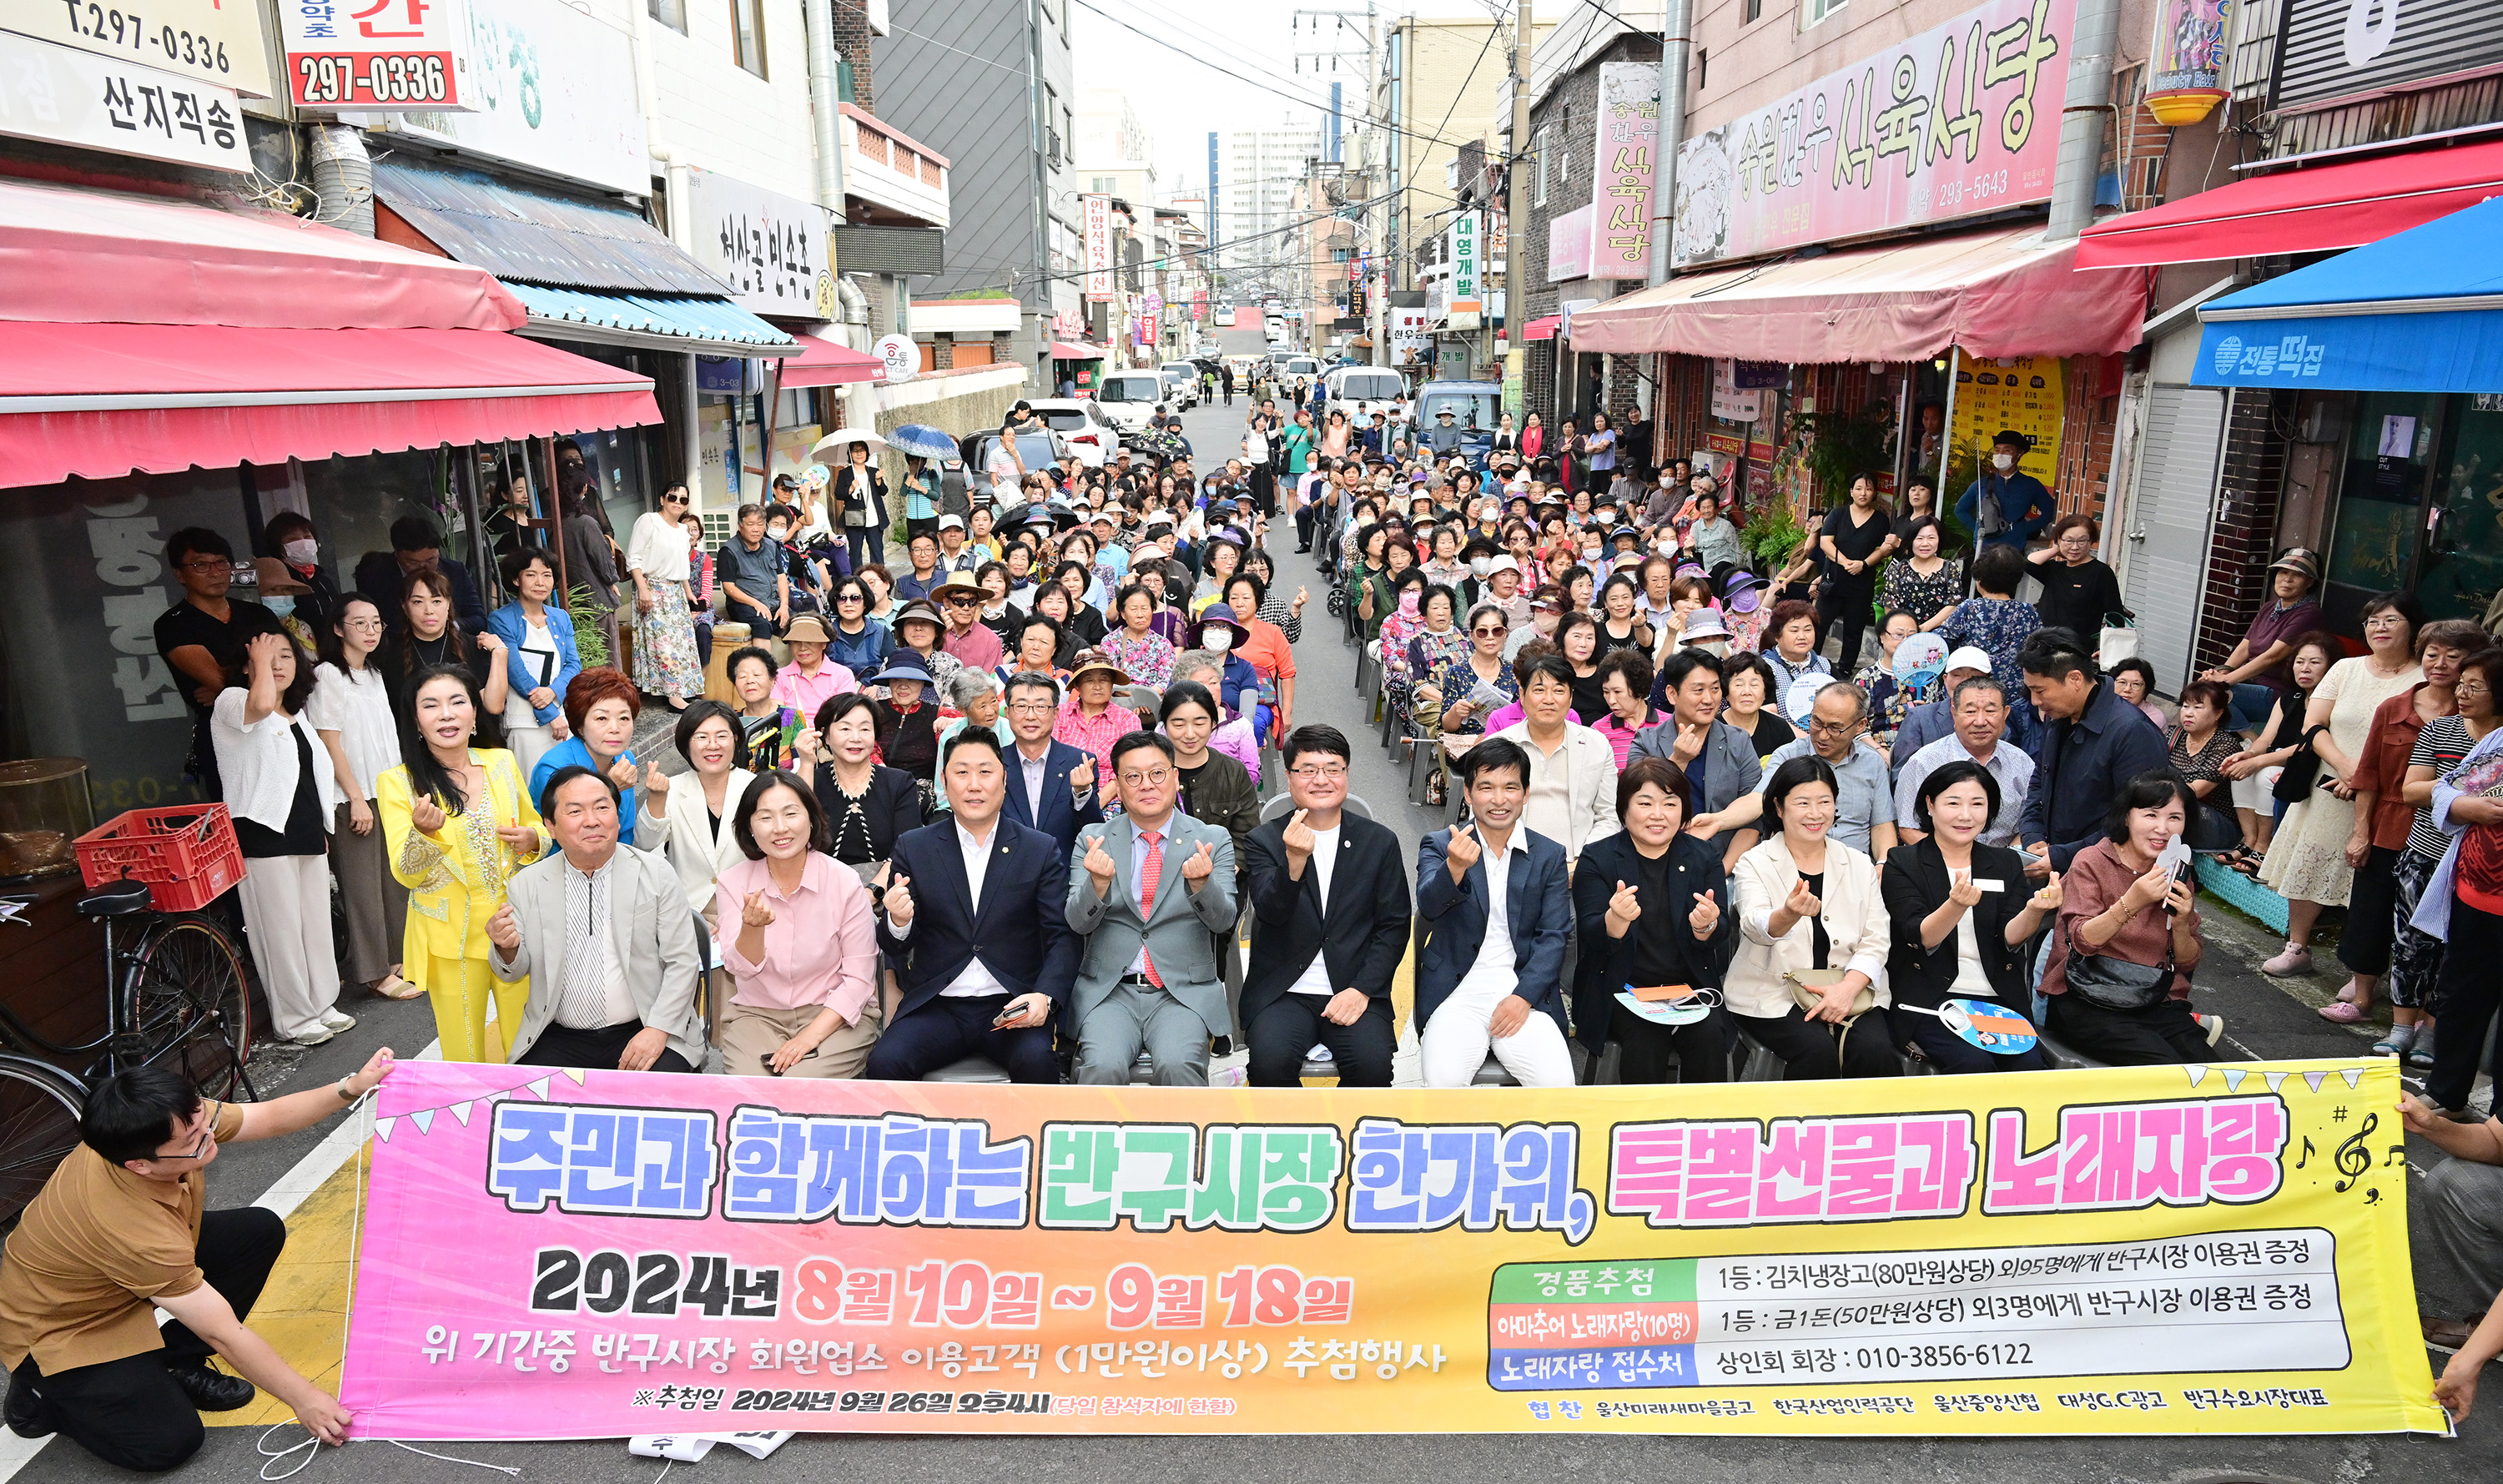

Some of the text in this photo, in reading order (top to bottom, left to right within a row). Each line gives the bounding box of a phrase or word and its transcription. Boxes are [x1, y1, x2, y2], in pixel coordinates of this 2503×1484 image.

[63, 0, 230, 74] T.297-0336
[299, 55, 446, 101] 297-0336
[1833, 0, 2058, 191] 식육식당
[2156, 72, 2215, 90] Beauty Hair
[103, 76, 236, 150] 산지직송
[1607, 147, 1651, 261] 식육식당
[1457, 218, 1473, 296] 대영개발
[2239, 335, 2325, 379] 전통떡집
[720, 378, 739, 386] 3-03
[2453, 590, 2473, 603] Hair
[492, 1097, 2286, 1242] 주민과 함께하는 반구시장 한가위, 특별선물과 노래자랑
[1533, 1267, 1654, 1297] 경품추첨
[1719, 1265, 1751, 1290] 1등
[1766, 1258, 1995, 1290] 김치냉장고(80만원상당)
[1997, 1250, 2103, 1278] 외95명에게
[2106, 1243, 2189, 1271] 반구시장
[2194, 1240, 2261, 1266] 이용권
[2264, 1238, 2310, 1264] 증정
[531, 1250, 779, 1317] 2024년
[795, 1259, 895, 1322] 8월
[906, 1262, 1042, 1326] 10일
[1108, 1265, 1205, 1328] 9월
[1218, 1267, 1352, 1326] 18일
[1721, 1310, 1755, 1332] 1등
[1774, 1297, 1966, 1331] 금1돈(50만원상당)
[1972, 1292, 2082, 1320] 외3명에게
[2088, 1288, 2183, 1316] 반구시장
[2189, 1285, 2258, 1312] 이용권
[2263, 1283, 2312, 1310] 증정
[1498, 1309, 1691, 1344] 아마추어 노래자랑(10명)
[421, 1325, 1448, 1381] 위 기간중 반구시장 회원업소 이용고객 (1만원이상) 추첨행사
[1500, 1350, 1684, 1383] 노래자랑 접수처
[1716, 1350, 1785, 1376] 상인회
[1790, 1348, 1837, 1374] 회장
[1856, 1344, 2034, 1370] 010-3856-6122
[732, 1391, 837, 1412] 2024년
[841, 1391, 888, 1413] 9월
[889, 1391, 954, 1414] 26일
[1100, 1396, 1183, 1416] 참석자에
[1188, 1397, 1237, 1416] 한함)
[1595, 1400, 1756, 1417] 울산미래새마을금고
[1773, 1396, 1916, 1416] 한국산업인력공단
[1933, 1393, 2040, 1413] 울산중앙신협
[2057, 1389, 2168, 1411] 대성G.C광고
[2183, 1388, 2330, 1411] 반구수요시장대표
